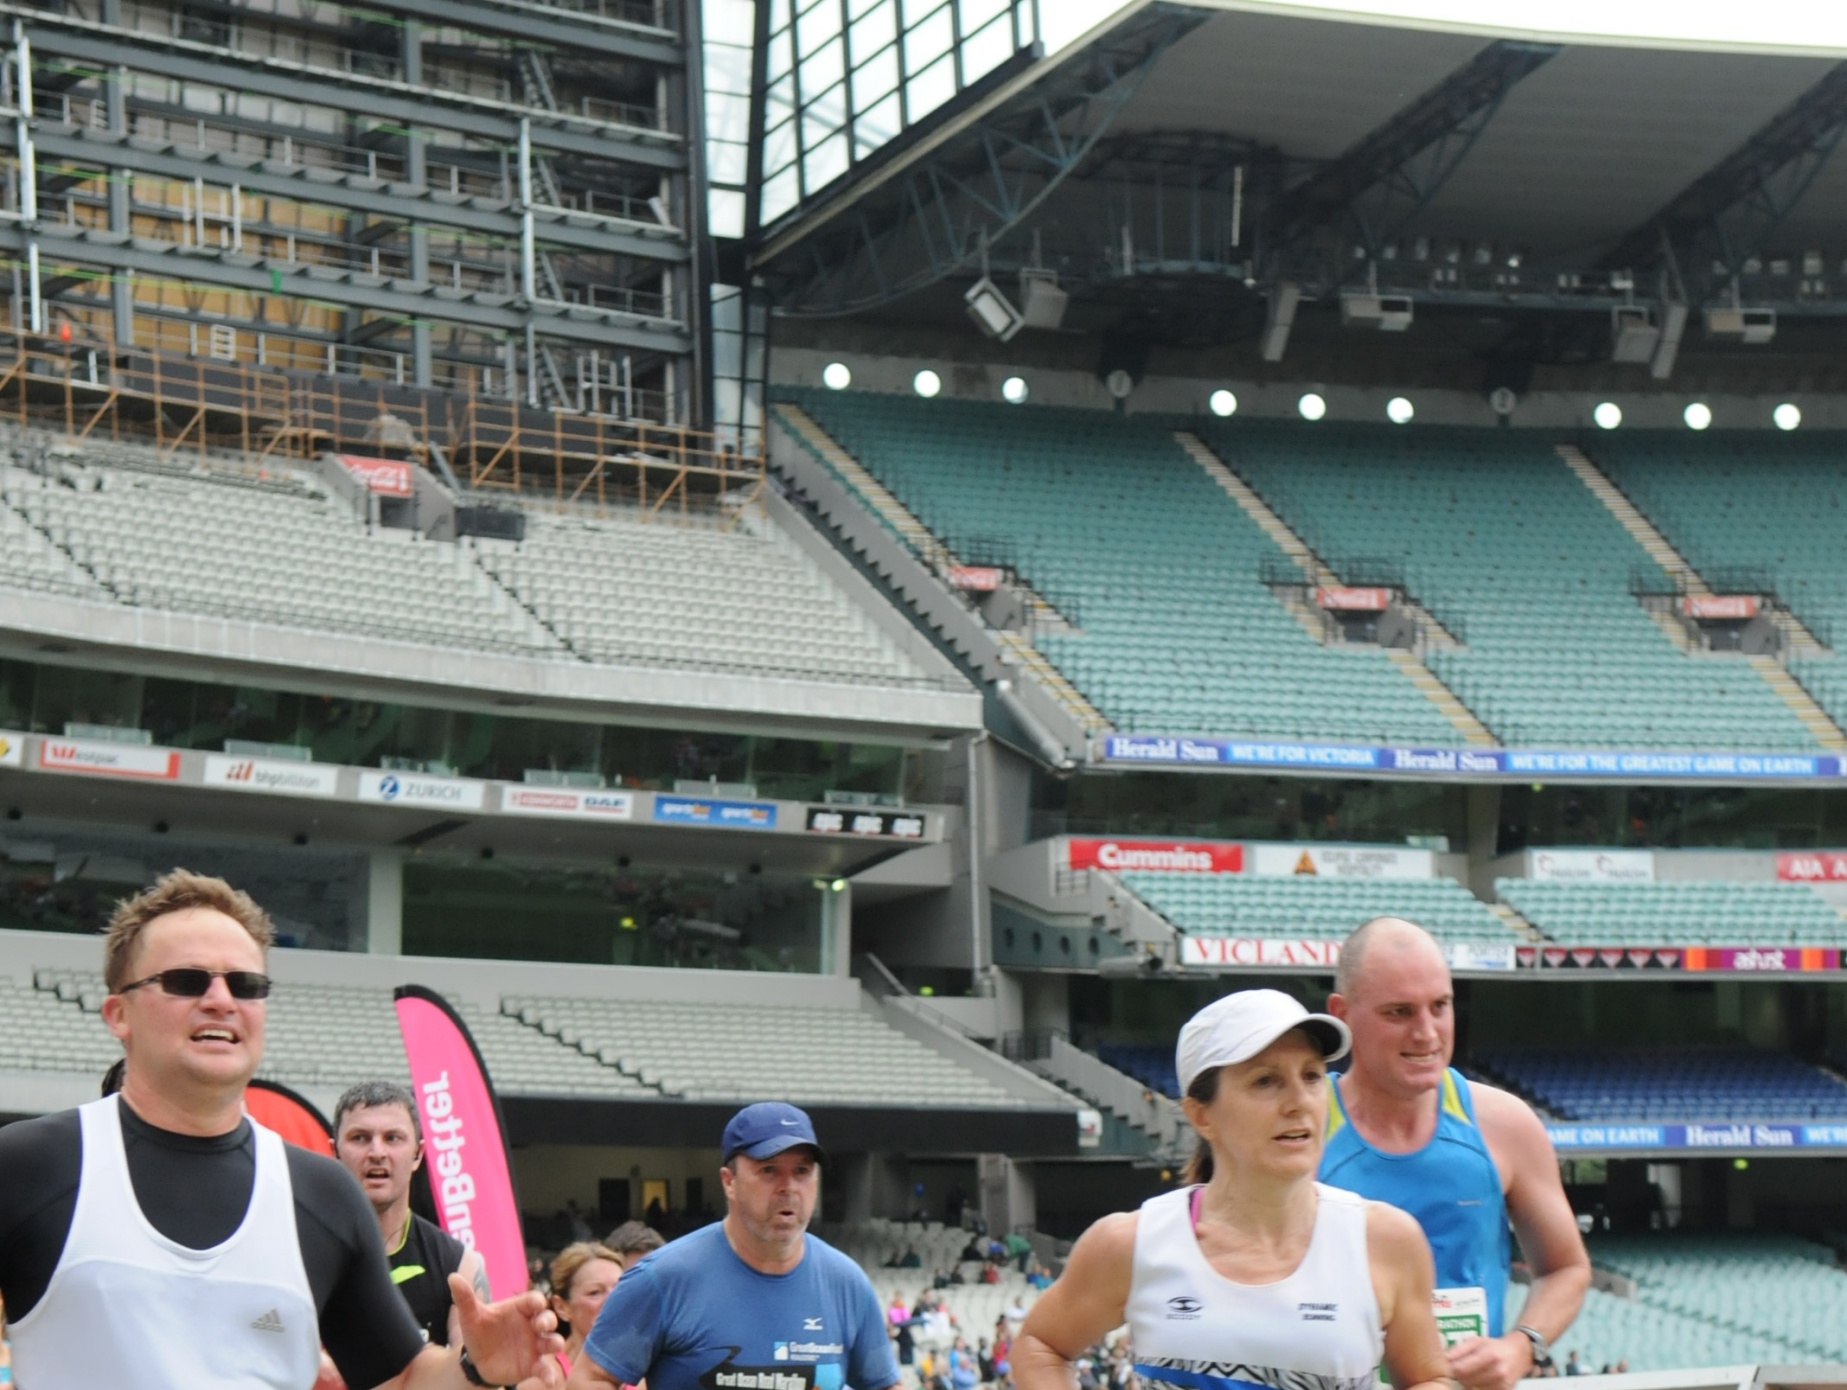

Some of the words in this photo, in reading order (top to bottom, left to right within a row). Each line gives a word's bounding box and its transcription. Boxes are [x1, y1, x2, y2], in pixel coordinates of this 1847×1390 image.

[1111, 737, 1177, 759] Herald
[1180, 741, 1219, 761] Sun
[1231, 744, 1276, 761] WE'RE
[1278, 746, 1307, 762] FOR
[1308, 746, 1375, 766] VICTORIA
[1395, 748, 1457, 770] Herald
[1460, 752, 1498, 772] Sun
[1511, 755, 1557, 770] WE'RE
[1558, 756, 1587, 771] FOR
[1589, 756, 1618, 771] THE
[1620, 757, 1691, 773] GREATEST
[1694, 758, 1738, 773] GAME
[1739, 759, 1761, 773] ON
[1763, 759, 1812, 774] EARTH
[406, 781, 462, 801] ZURICH
[1098, 843, 1213, 871] Cummins
[1789, 860, 1824, 878] AIA
[1549, 1128, 1579, 1145] AME
[1581, 1128, 1606, 1145] ON
[1607, 1128, 1659, 1145] EARTH
[1685, 1125, 1751, 1146] Herald
[1754, 1126, 1793, 1146] Sun
